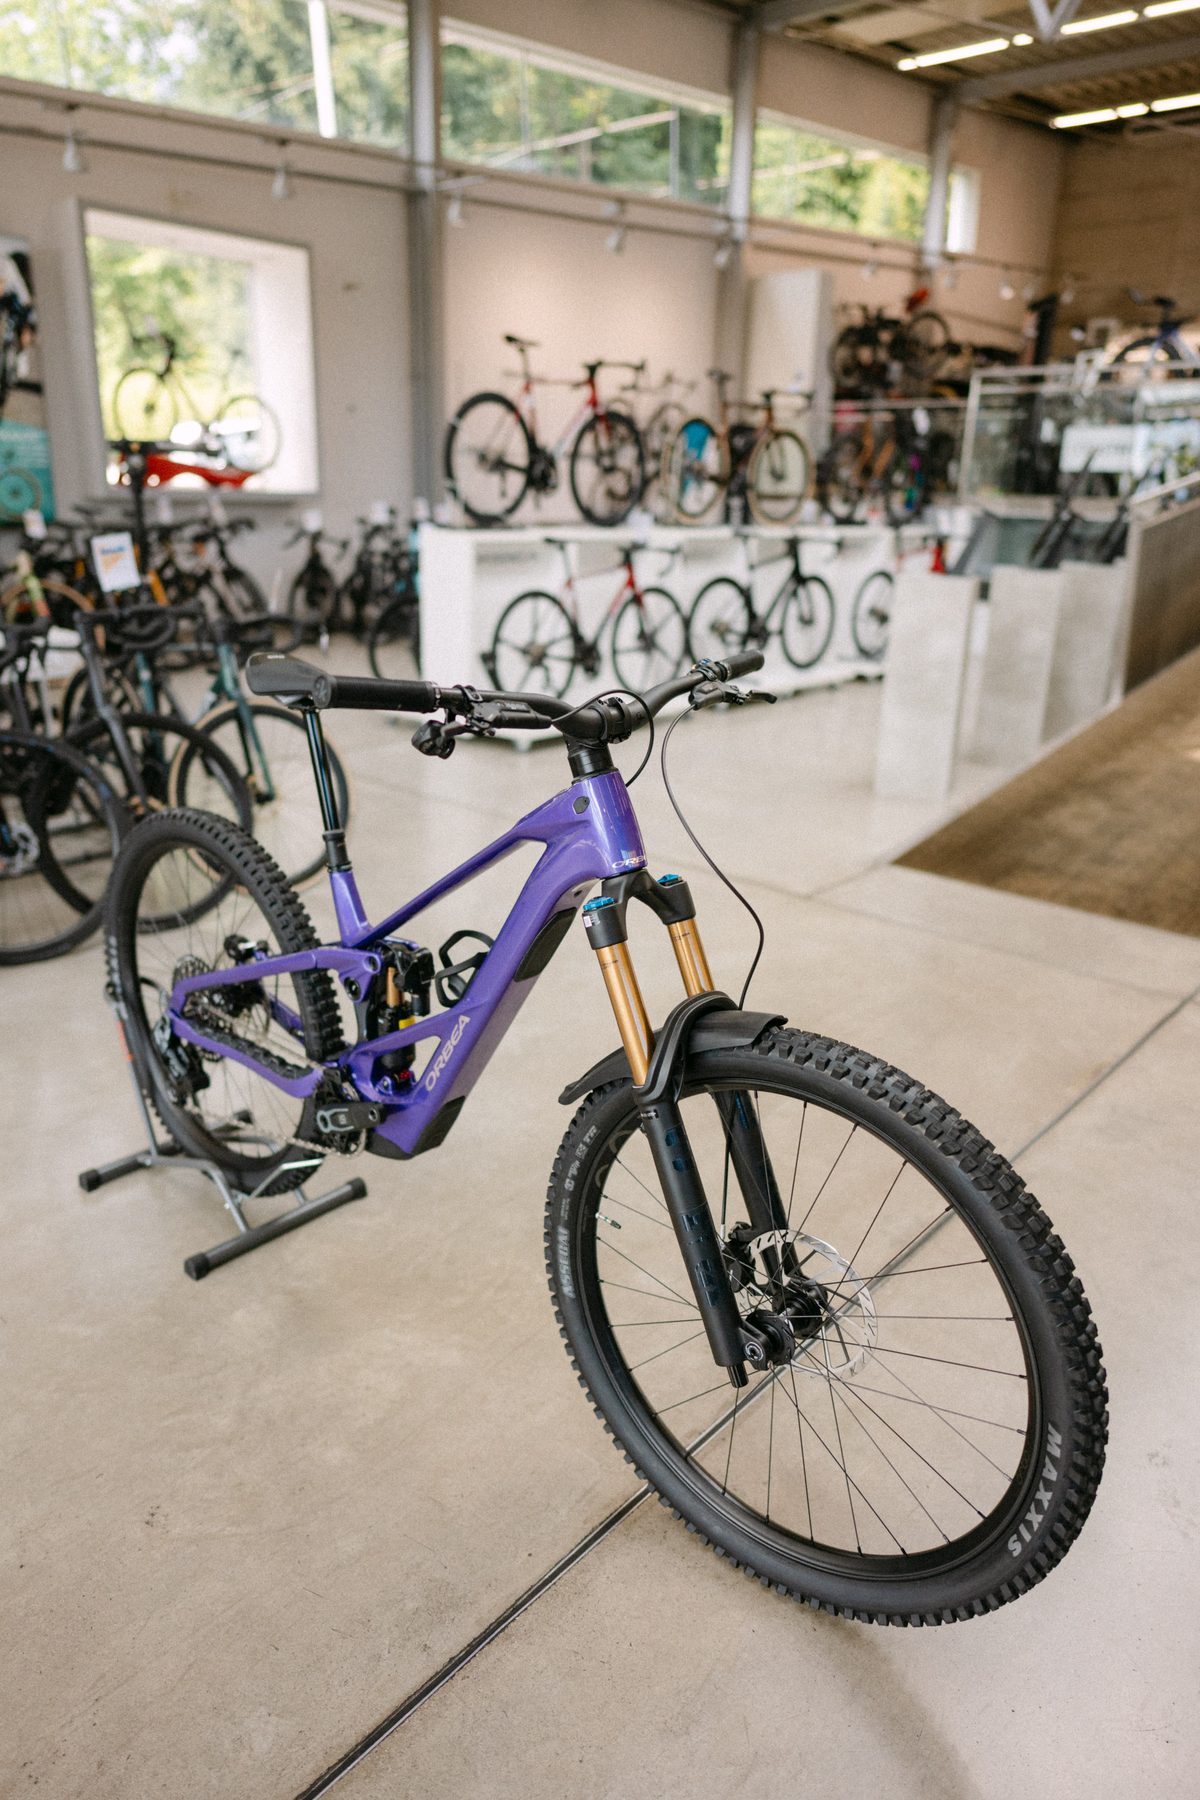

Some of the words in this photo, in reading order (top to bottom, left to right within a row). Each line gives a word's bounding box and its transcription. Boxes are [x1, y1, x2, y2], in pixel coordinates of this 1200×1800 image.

[611, 855, 645, 868] ORB
[425, 1015, 471, 1091] ORBEA
[1008, 1422, 1062, 1557] MAXXIS
